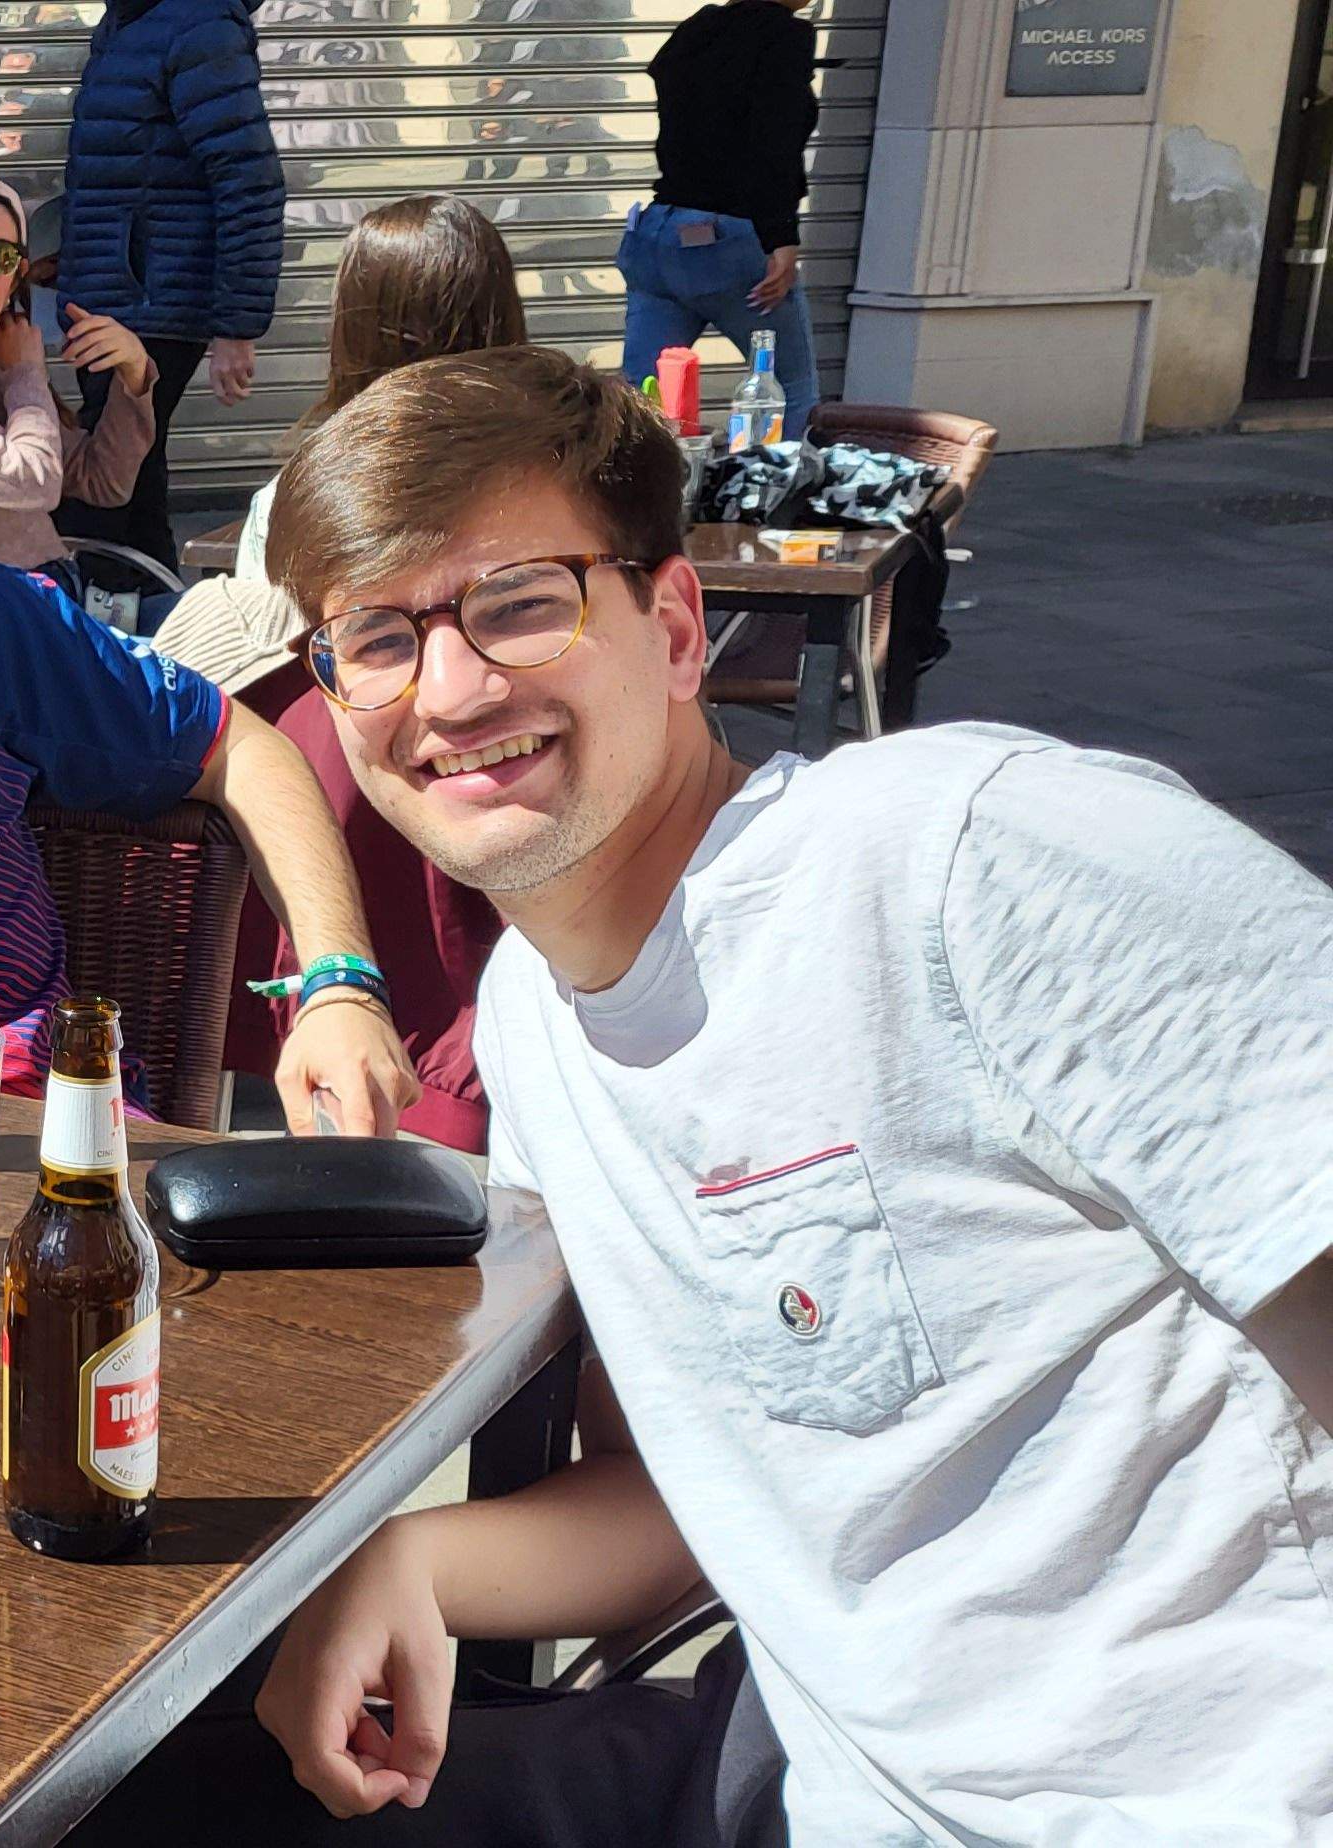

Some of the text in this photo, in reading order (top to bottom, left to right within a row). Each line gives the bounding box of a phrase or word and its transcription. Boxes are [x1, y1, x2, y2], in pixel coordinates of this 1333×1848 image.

[1021, 28, 1147, 44] MICHAEL KORS
[1047, 49, 1116, 65] ACCESS
[112, 1346, 135, 1372] CIN
